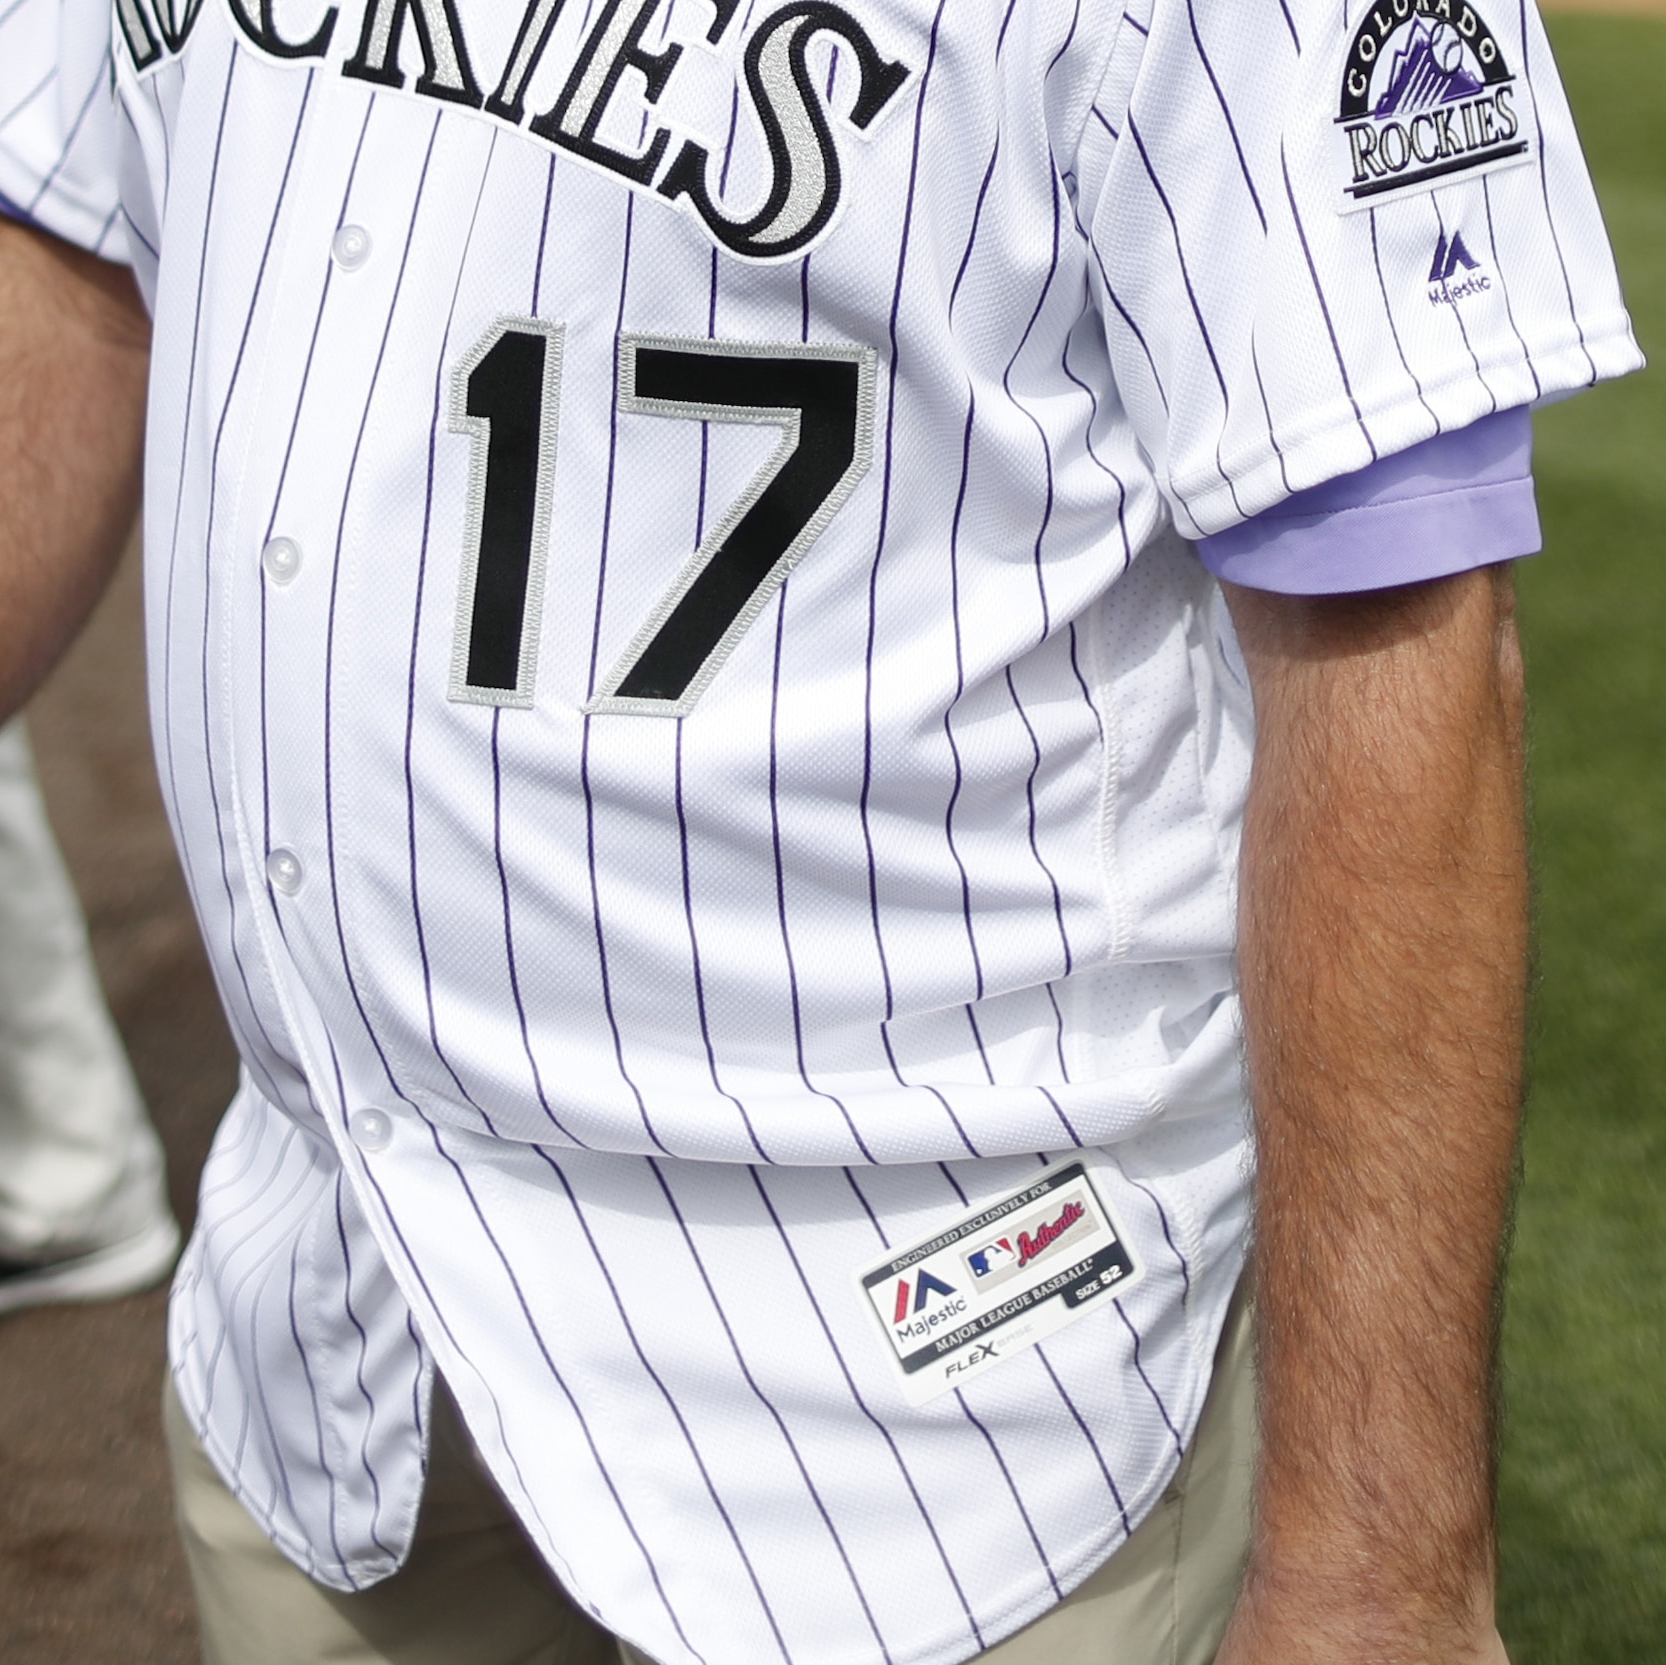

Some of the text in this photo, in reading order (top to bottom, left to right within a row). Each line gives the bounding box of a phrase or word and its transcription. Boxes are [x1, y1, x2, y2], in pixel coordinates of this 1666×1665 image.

[1344, 85, 1519, 183] ROCKIES
[1428, 273, 1491, 307] Majestic
[447, 315, 877, 716] 17
[891, 1229, 960, 1272] ENGINEERED
[960, 1193, 1029, 1236] EXCLUSIVELY
[1030, 1182, 1052, 1200] FOR
[1018, 1200, 1086, 1268] Authentic
[1075, 1265, 1123, 1300] SIZE 52
[896, 1297, 967, 1343] Majestic
[935, 1323, 980, 1352] MAJOR
[979, 1295, 1032, 1328] LEAGUE
